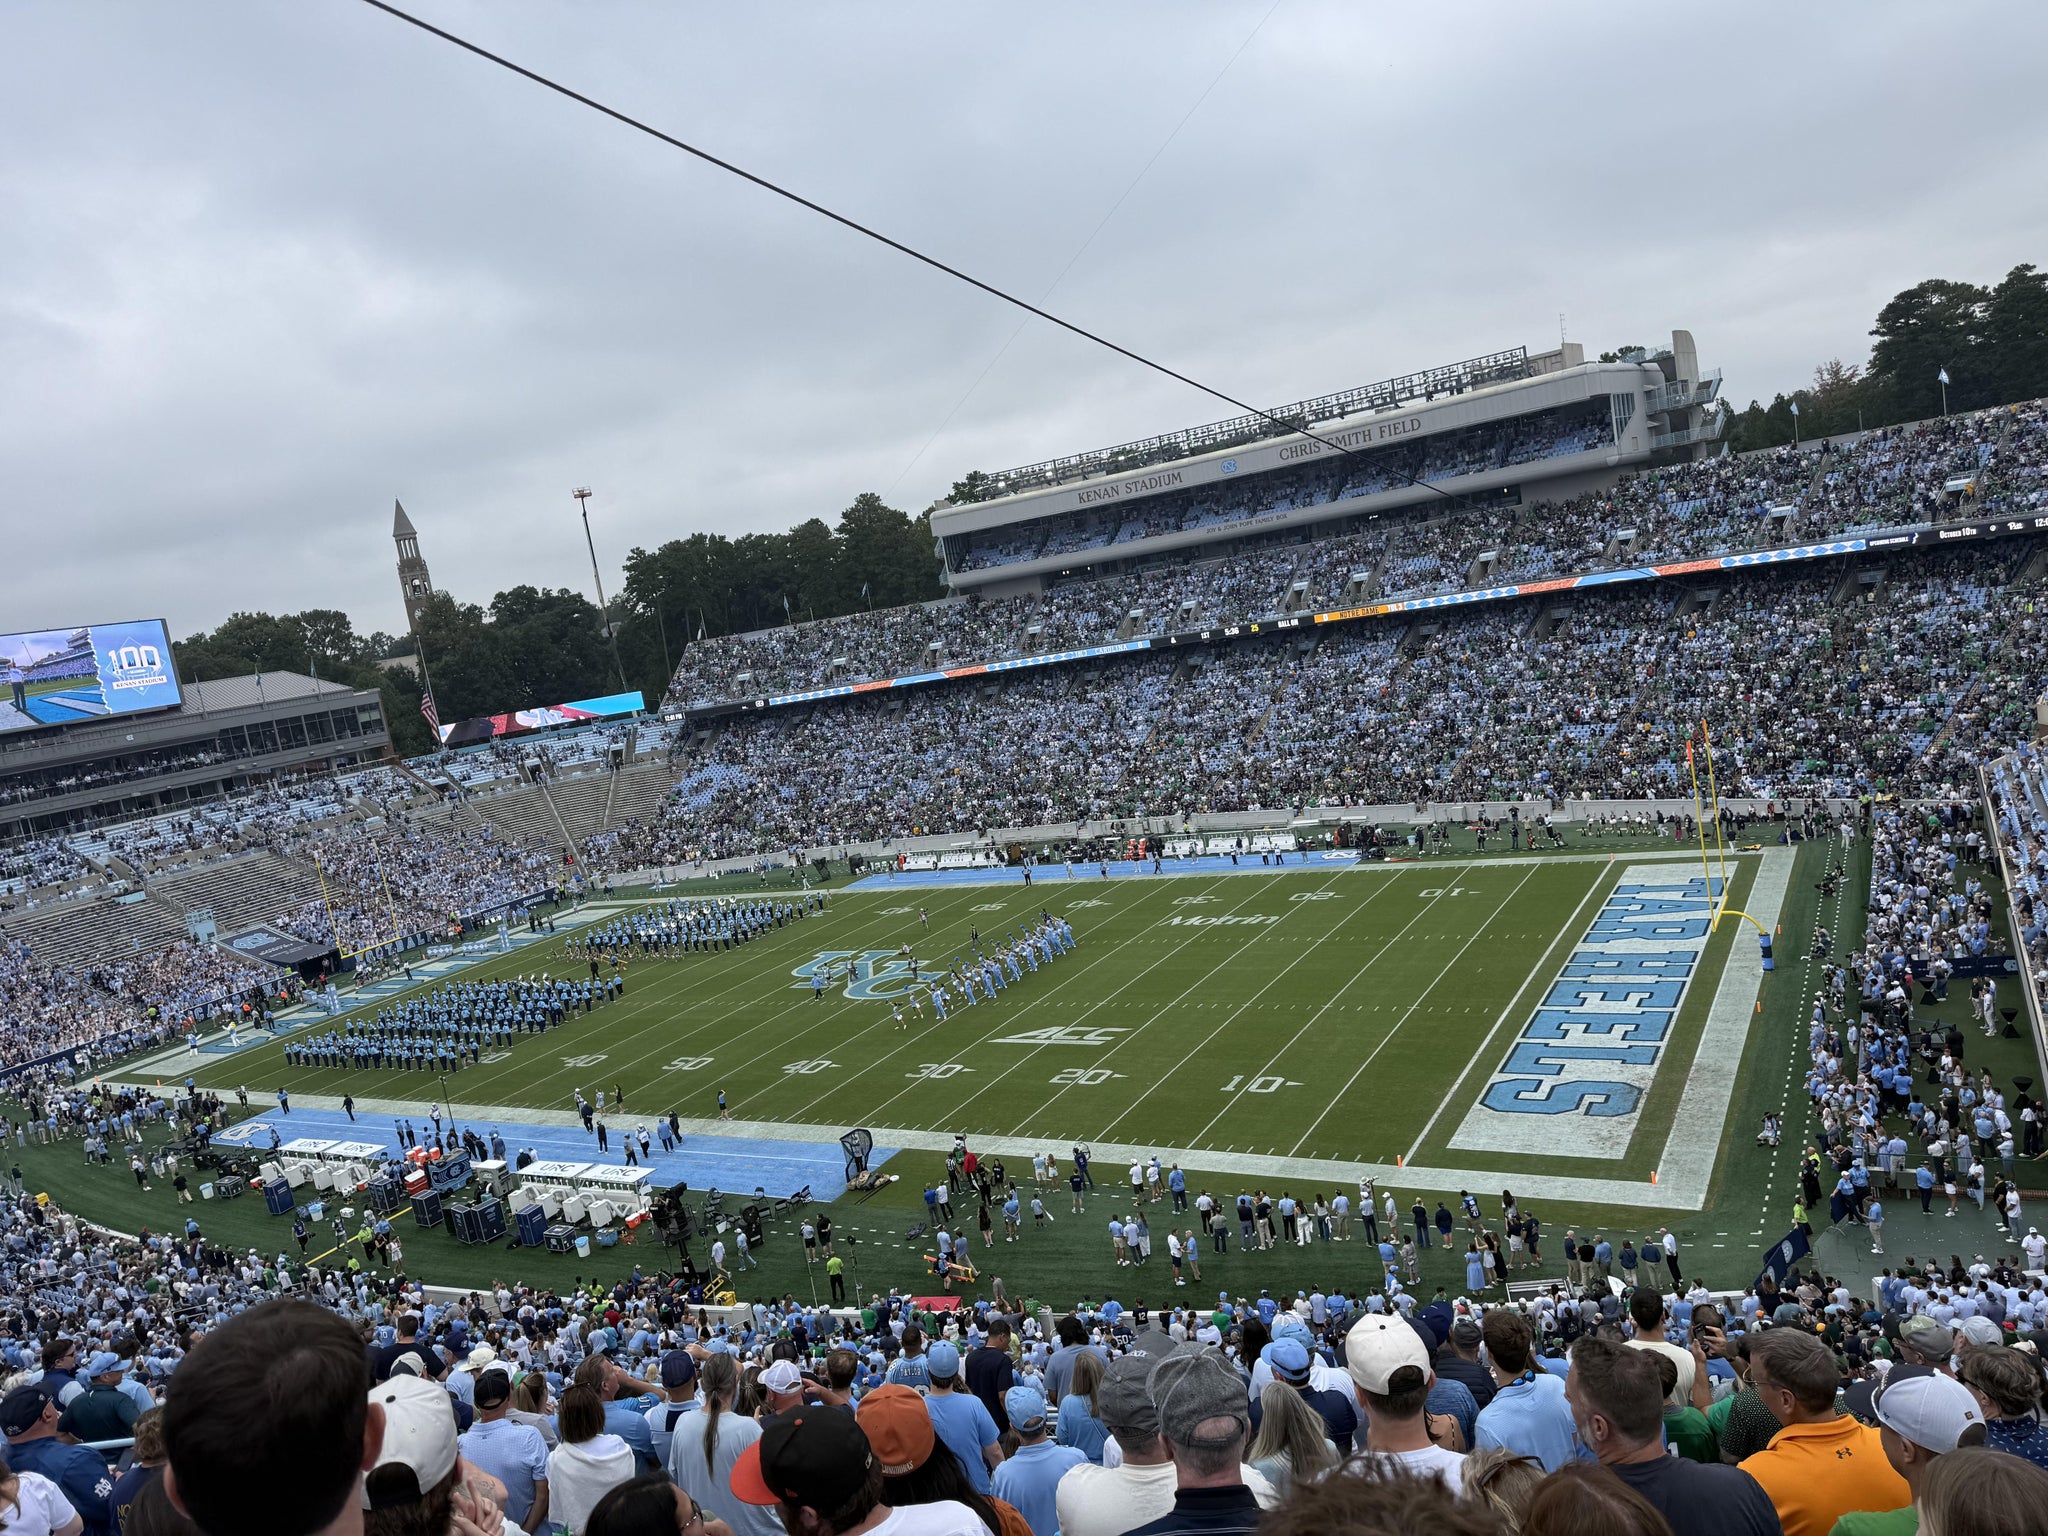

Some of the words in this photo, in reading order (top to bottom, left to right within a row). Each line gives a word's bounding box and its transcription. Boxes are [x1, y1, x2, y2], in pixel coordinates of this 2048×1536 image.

[1279, 440, 1321, 461] CHRIS
[1327, 429, 1373, 451] SMITH
[1379, 418, 1421, 439] FIELD
[1078, 485, 1120, 504] KENAN
[1124, 472, 1183, 494] STADIUM
[1255, 516, 1274, 524] FAMILY
[1276, 513, 1288, 521] BOX
[1340, 609, 1360, 619] NOTRE
[1361, 607, 1380, 617] DAME
[1201, 632, 1210, 640] 1ST
[1250, 624, 1259, 633] 25
[1277, 620, 1291, 628] BALL
[1095, 643, 1128, 655] CAROLINA
[109, 645, 162, 674] 100
[137, 677, 164, 686] STADIUM
[1288, 892, 1336, 901] 20
[1582, 876, 1728, 943] TAR
[1158, 913, 1280, 927] Motrin
[1000, 1026, 1134, 1042] ACC
[1479, 950, 1699, 1117] HEELS
[563, 1054, 609, 1067] 40
[662, 1057, 714, 1070] 50
[781, 1060, 832, 1074] 40
[905, 1063, 965, 1079] 30
[1048, 1068, 1114, 1085] 20
[1220, 1074, 1285, 1093] 10
[540, 1163, 576, 1172] UNC
[600, 1167, 637, 1177] UNC
[2003, 1271, 2009, 1281] 5
[1138, 1312, 1146, 1321] 12
